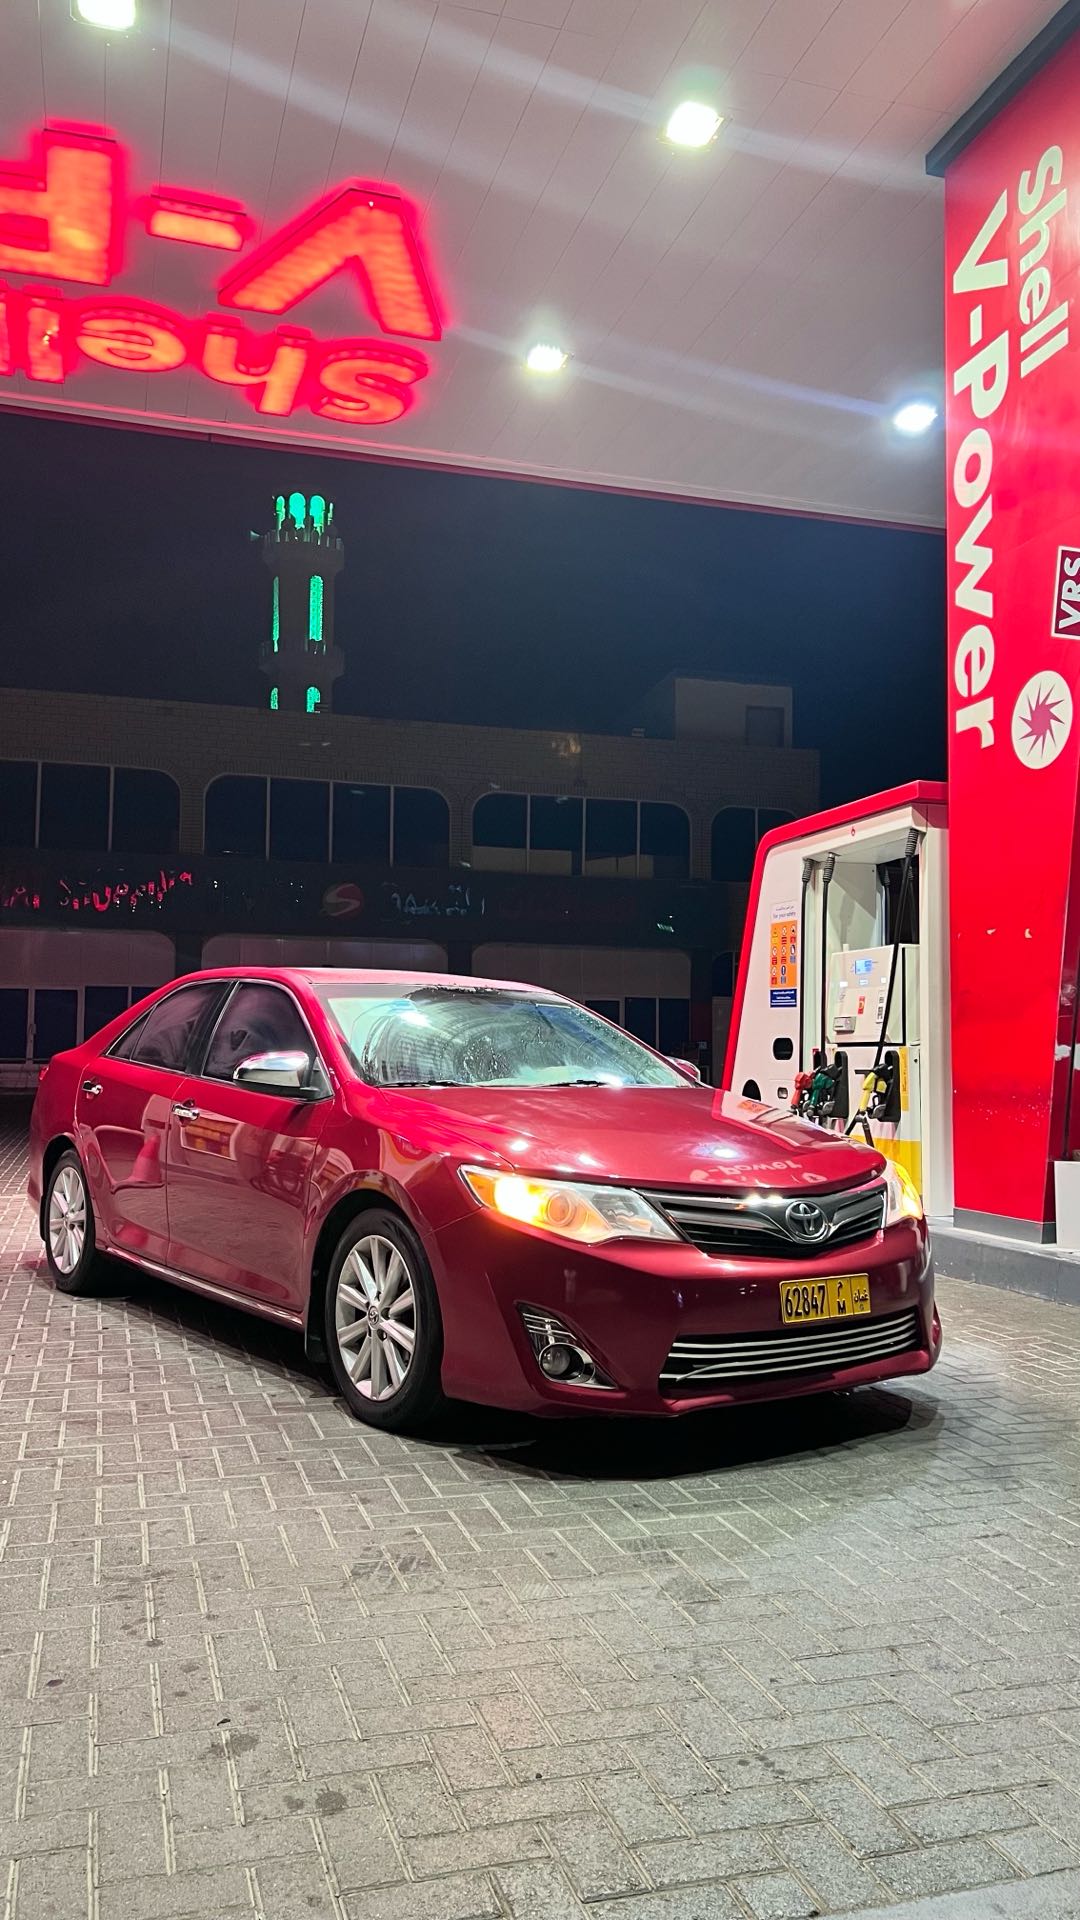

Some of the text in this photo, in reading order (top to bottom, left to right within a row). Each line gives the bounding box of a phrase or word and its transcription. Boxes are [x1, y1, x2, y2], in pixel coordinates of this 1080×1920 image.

[1018, 145, 1068, 379] shell
[953, 188, 1009, 749] V-Power
[785, 1285, 826, 1317] 62847
[837, 1299, 847, 1315] M
